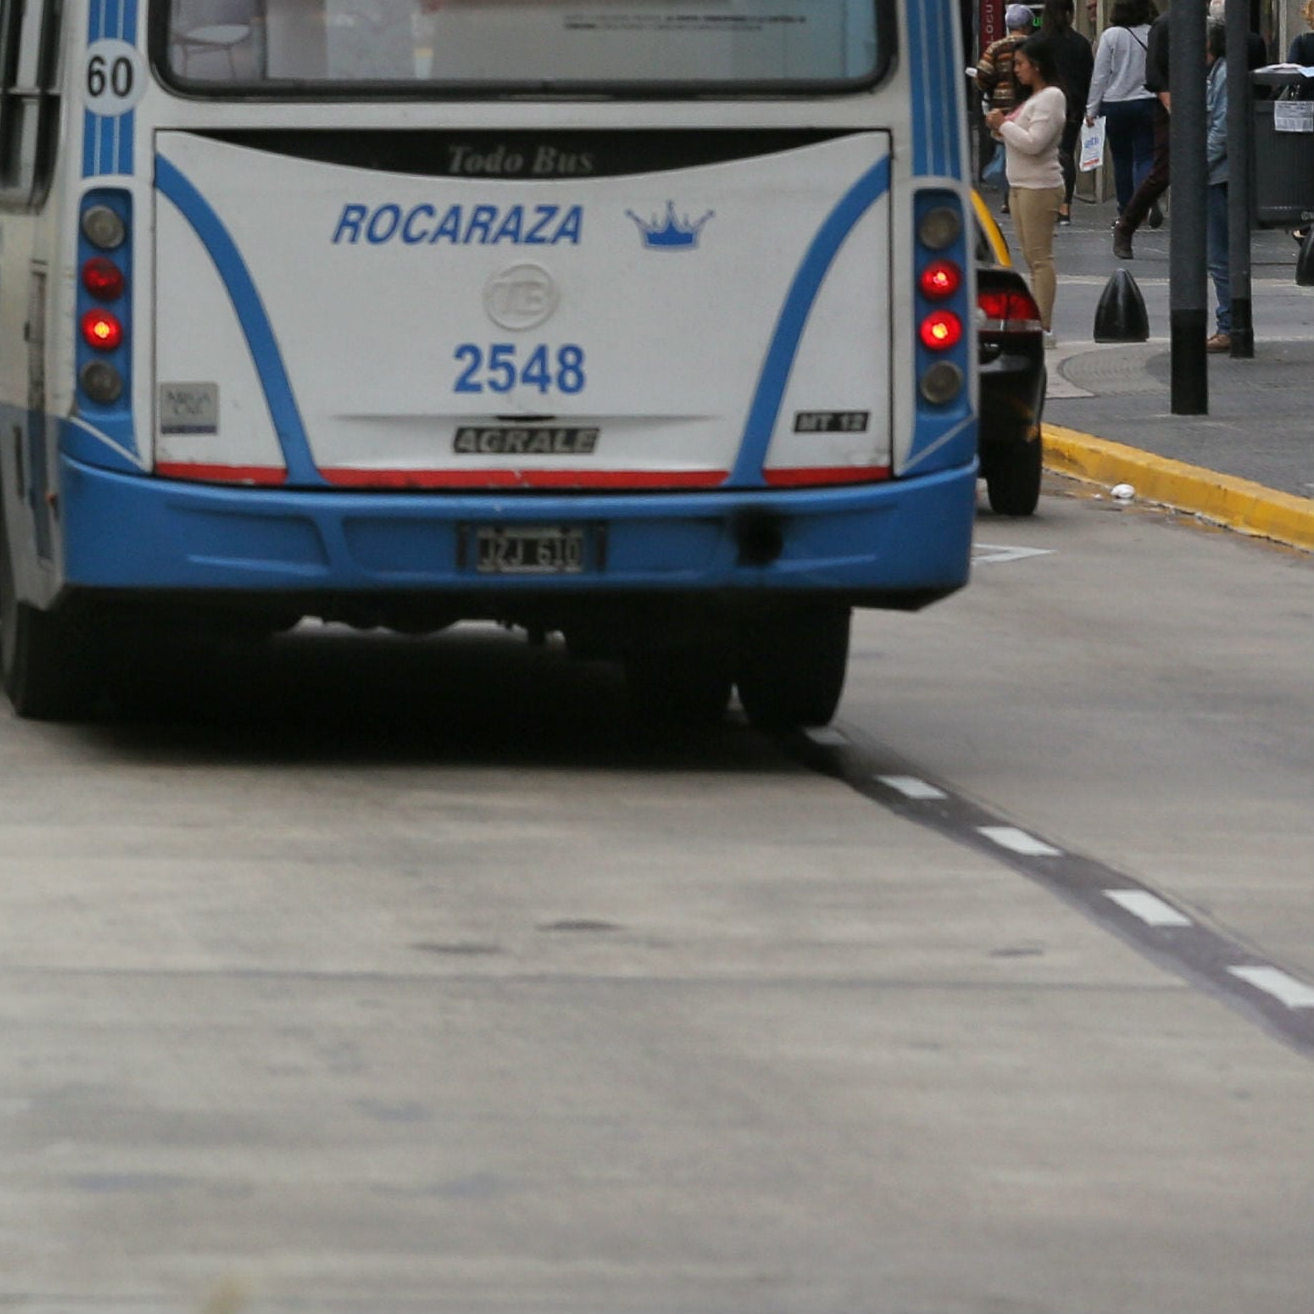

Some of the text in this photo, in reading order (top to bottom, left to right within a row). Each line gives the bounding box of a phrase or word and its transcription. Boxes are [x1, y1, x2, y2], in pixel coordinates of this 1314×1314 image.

[86, 56, 134, 98] 60
[449, 145, 595, 175] Todo Bus
[331, 202, 584, 246] ROCARAZA
[452, 342, 587, 395] 2548
[455, 428, 600, 454] AGRALE
